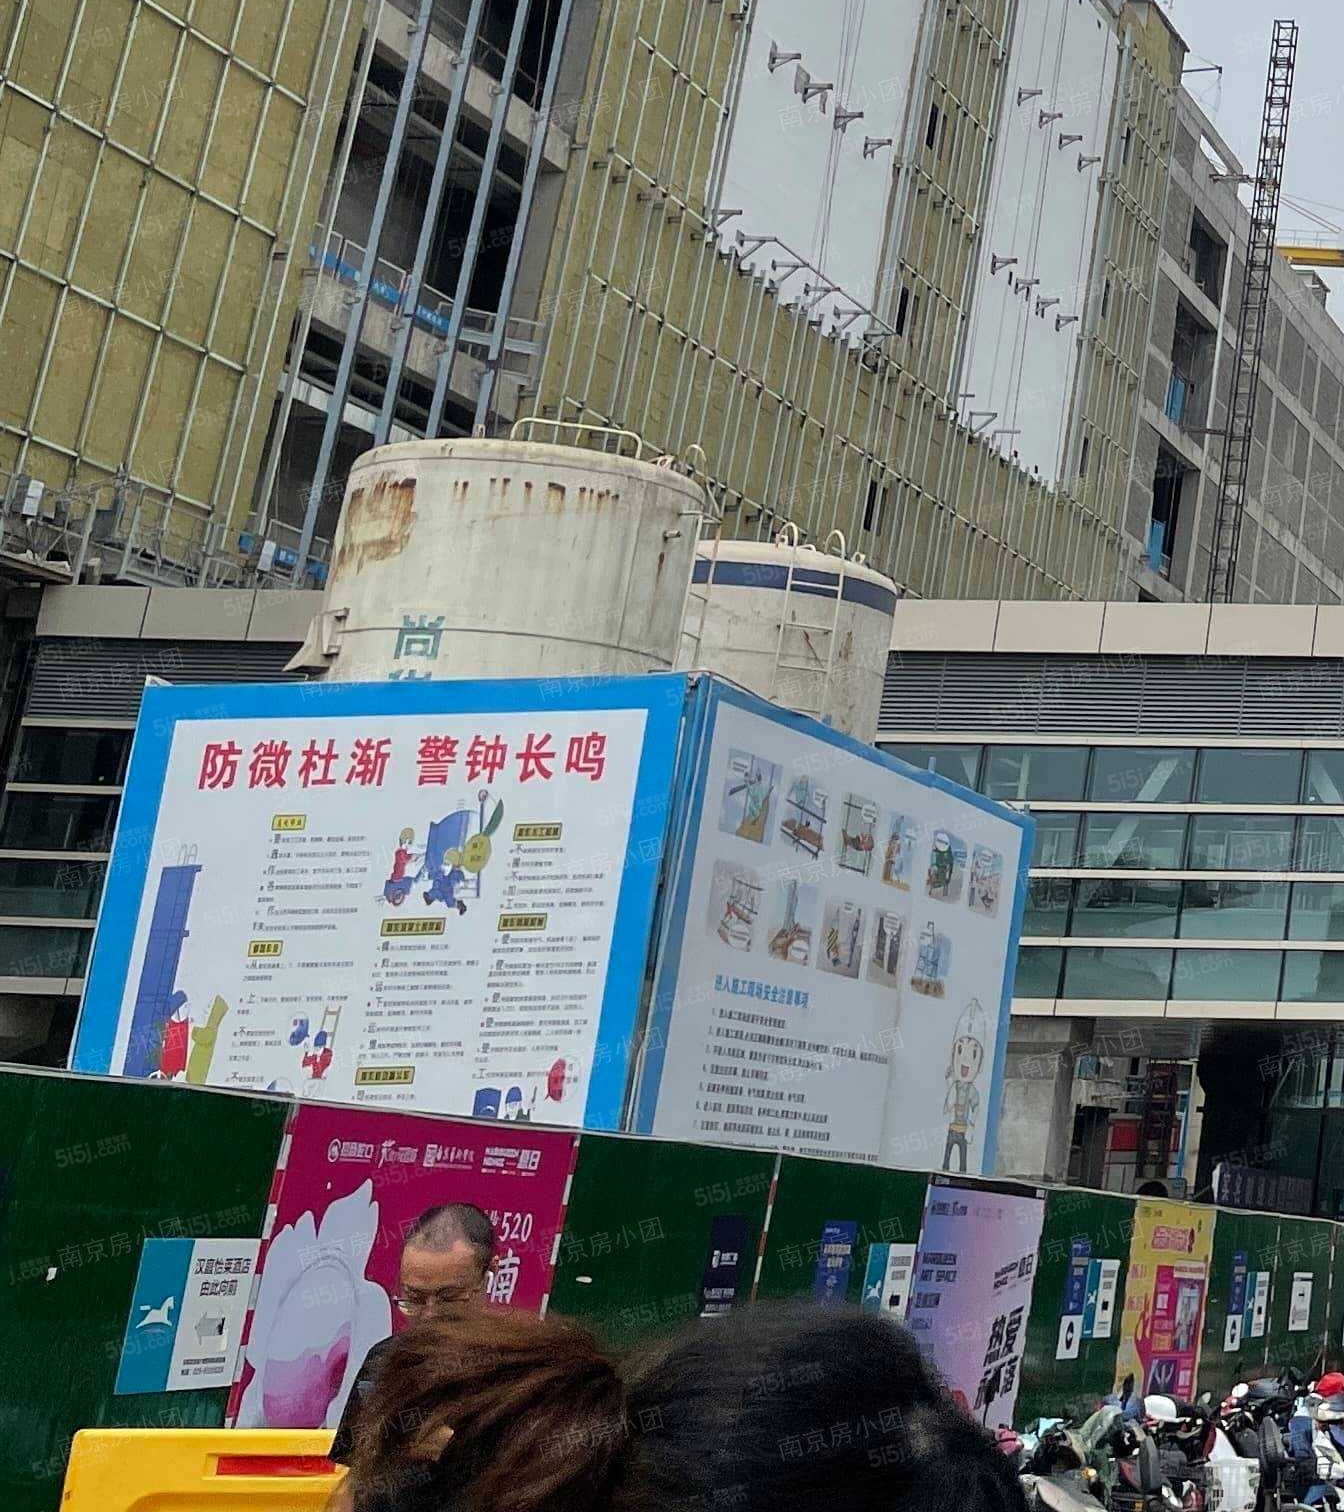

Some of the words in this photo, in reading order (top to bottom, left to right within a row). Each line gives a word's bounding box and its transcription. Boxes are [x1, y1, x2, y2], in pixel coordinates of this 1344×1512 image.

[198, 738, 393, 790] 防微杜渐
[415, 731, 608, 786] 警钟长鸣
[498, 1211, 533, 1243] 520
[193, 1257, 252, 1275] 汉庭怡莱酒店
[199, 1279, 239, 1297] 由此向前
